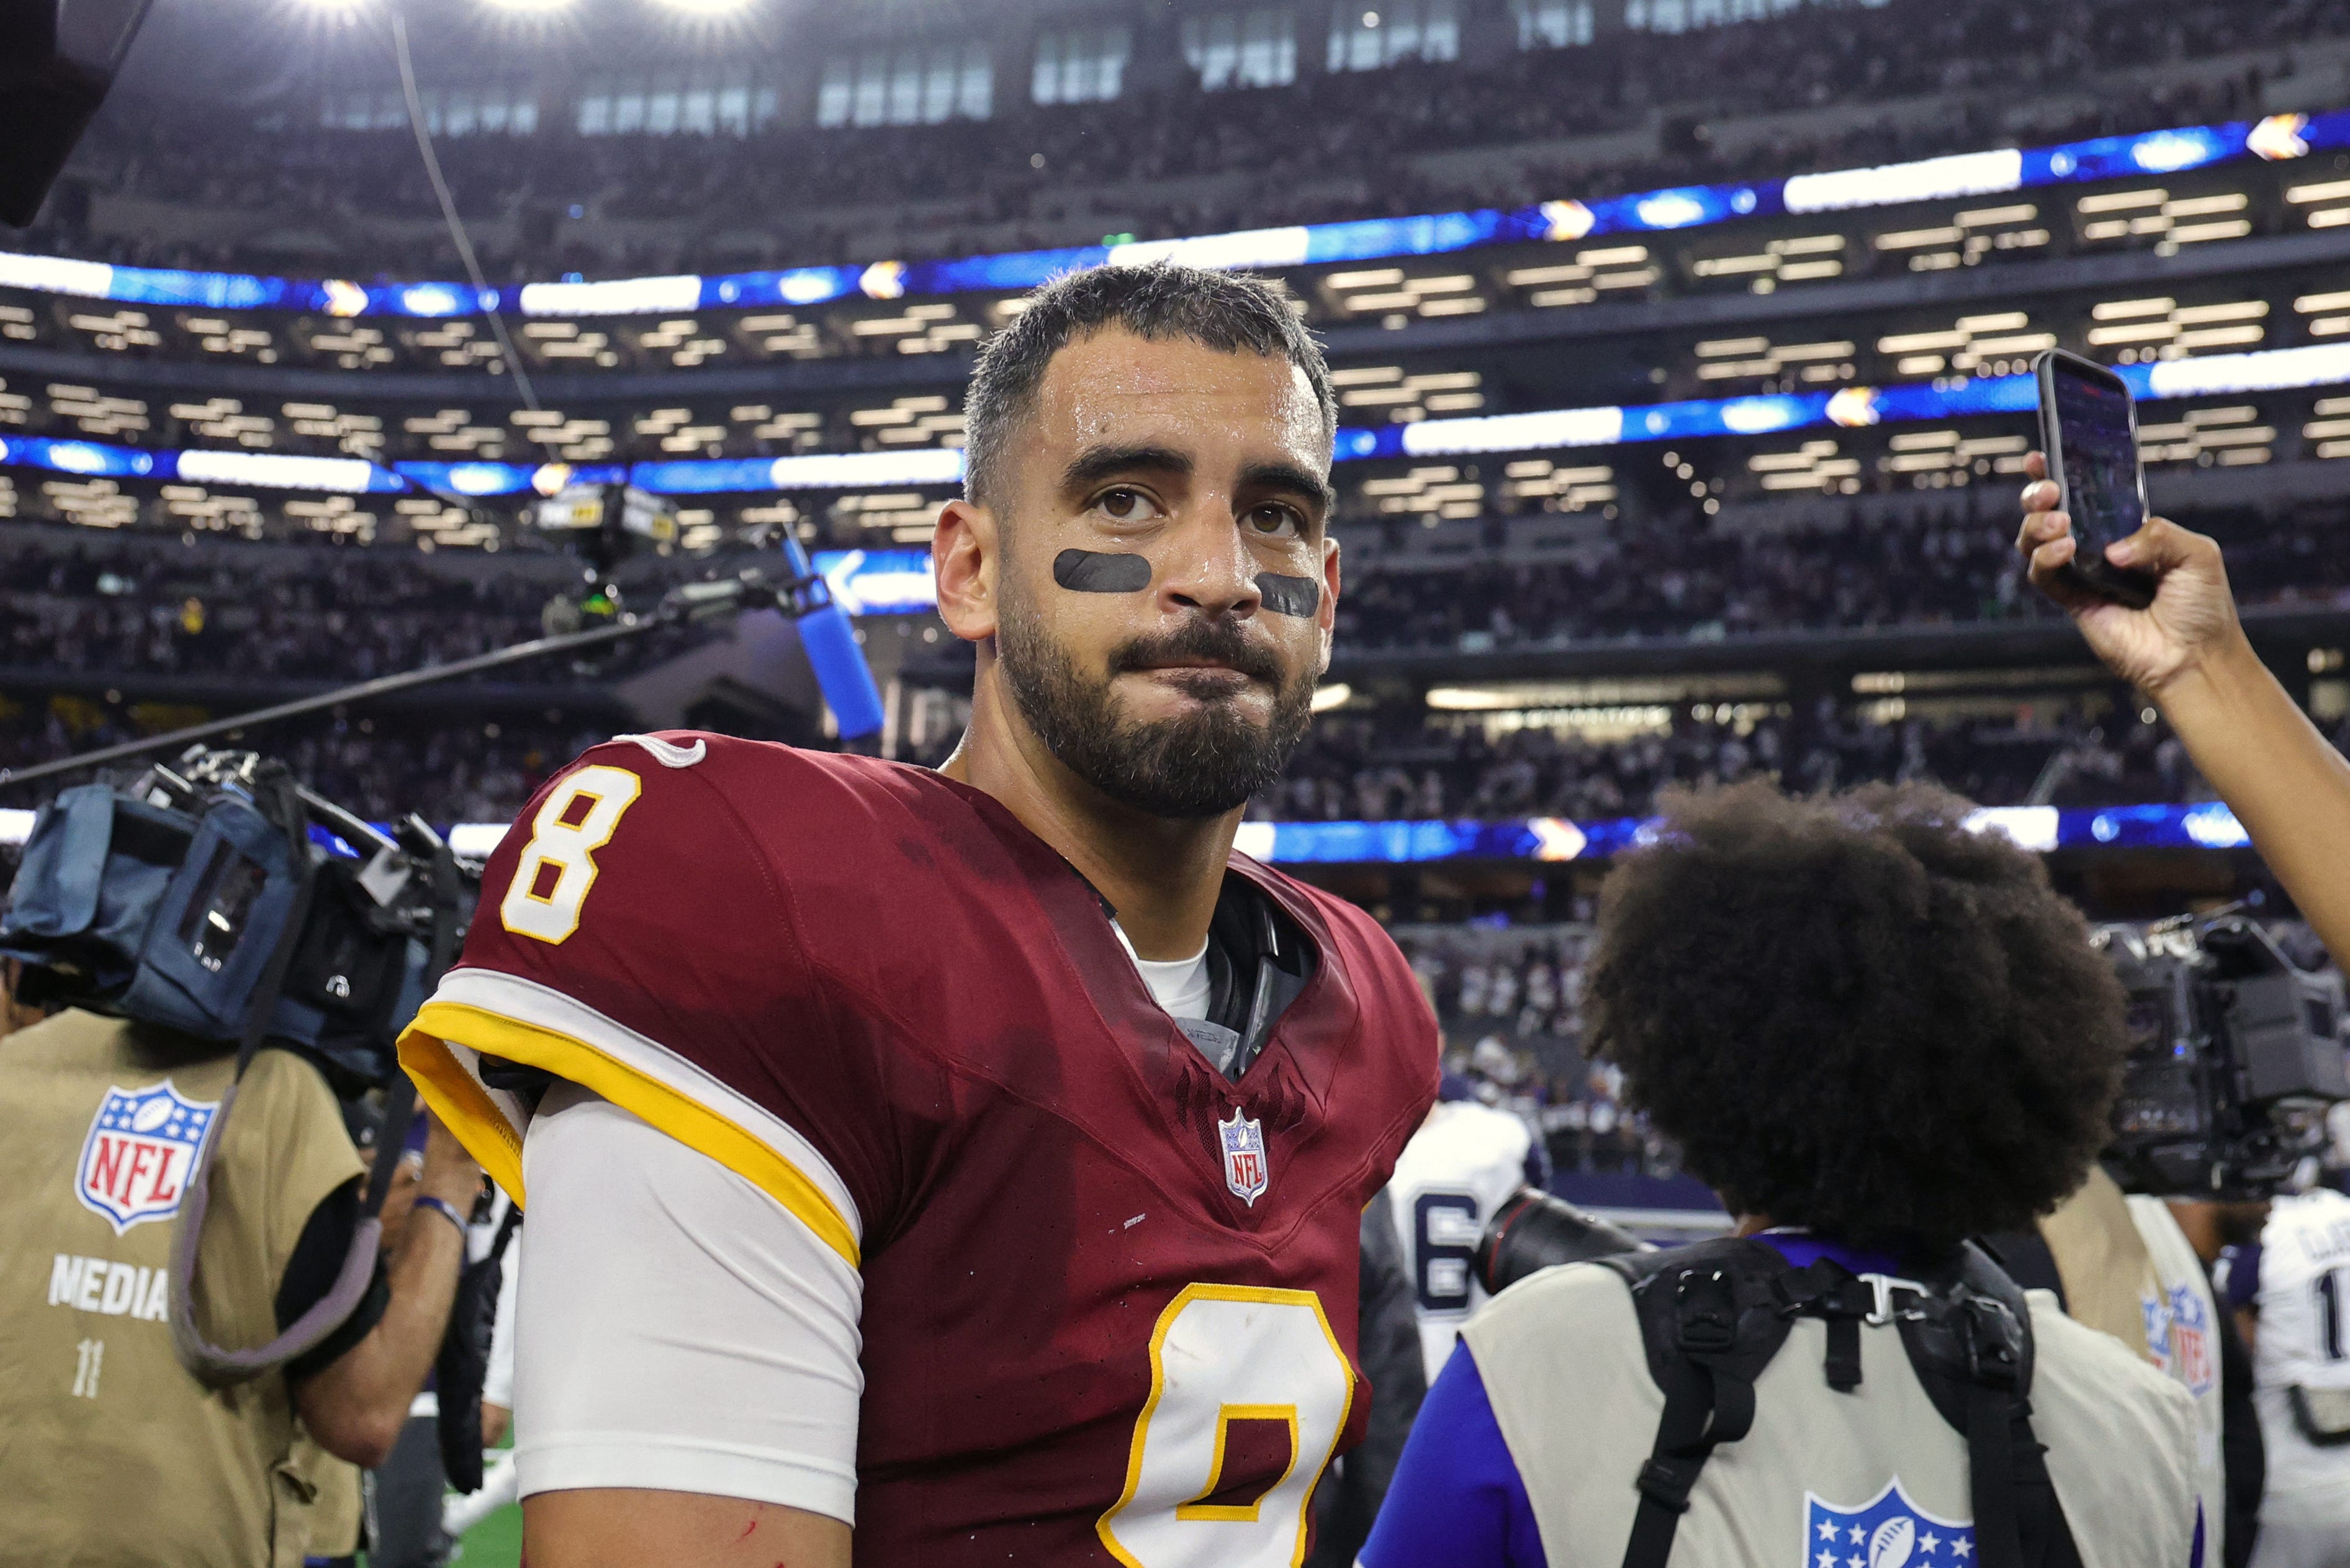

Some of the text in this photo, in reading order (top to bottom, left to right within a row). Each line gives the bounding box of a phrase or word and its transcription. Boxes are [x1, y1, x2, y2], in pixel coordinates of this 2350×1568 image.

[500, 765, 642, 945] 8
[89, 1137, 176, 1207] NFL
[1232, 1154, 1262, 1189] NFL
[48, 1252, 169, 1322] MEDIA
[71, 1337, 104, 1399] 11
